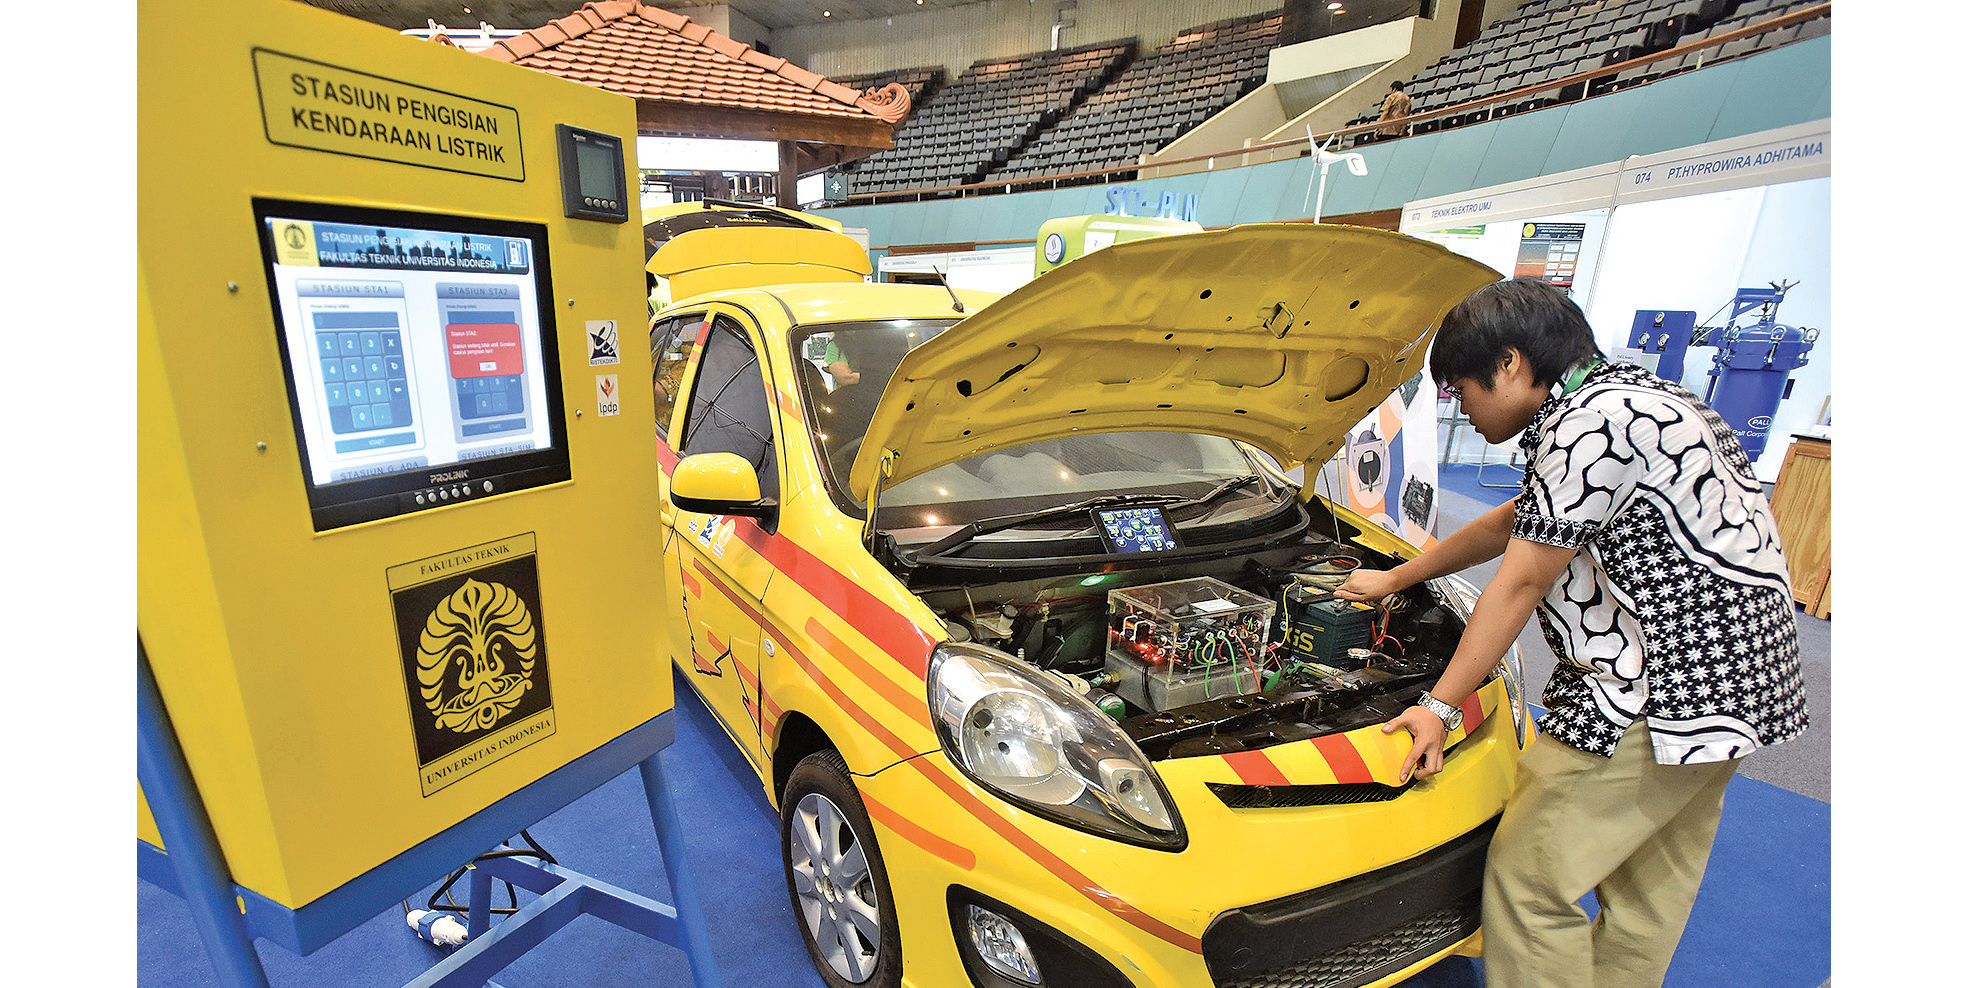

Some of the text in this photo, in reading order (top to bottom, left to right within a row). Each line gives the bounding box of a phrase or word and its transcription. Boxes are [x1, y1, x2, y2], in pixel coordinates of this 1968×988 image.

[291, 73, 499, 135] STASIUN PENGISIAN
[291, 106, 506, 164] KENDARAAN LISTRIK
[1634, 141, 1824, 185] 074 PT.HYPROWIRA ADHITAMA
[1104, 186, 1199, 222] STT-PLN
[1431, 208, 1451, 218] TEKNIK
[1451, 203, 1478, 216] ELEKTRO
[1478, 201, 1493, 212] UMJ
[321, 232, 363, 245] STASIUN
[463, 241, 492, 252] LISTRIK
[319, 250, 368, 264] FAKULTAS
[368, 252, 402, 265] TEKNIK
[402, 255, 456, 266] UNIVERSITAS
[457, 258, 497, 269] INDONESIA
[312, 284, 389, 294] STASIUN STA1
[448, 286, 509, 296] STASIUN STA2
[325, 340, 332, 350] 1
[346, 340, 353, 349] 2
[367, 339, 374, 348] 3
[329, 363, 378, 374] 4 5 6
[333, 387, 382, 399] 7 8 9
[599, 401, 619, 416] lpdp
[461, 449, 497, 461] STASIUN
[340, 466, 385, 480] STASIUN
[429, 469, 470, 484] PROLINK
[420, 544, 510, 575] FAKULTAS TEKNIK
[426, 719, 551, 785] UNIVERSITAS INDONESIA
